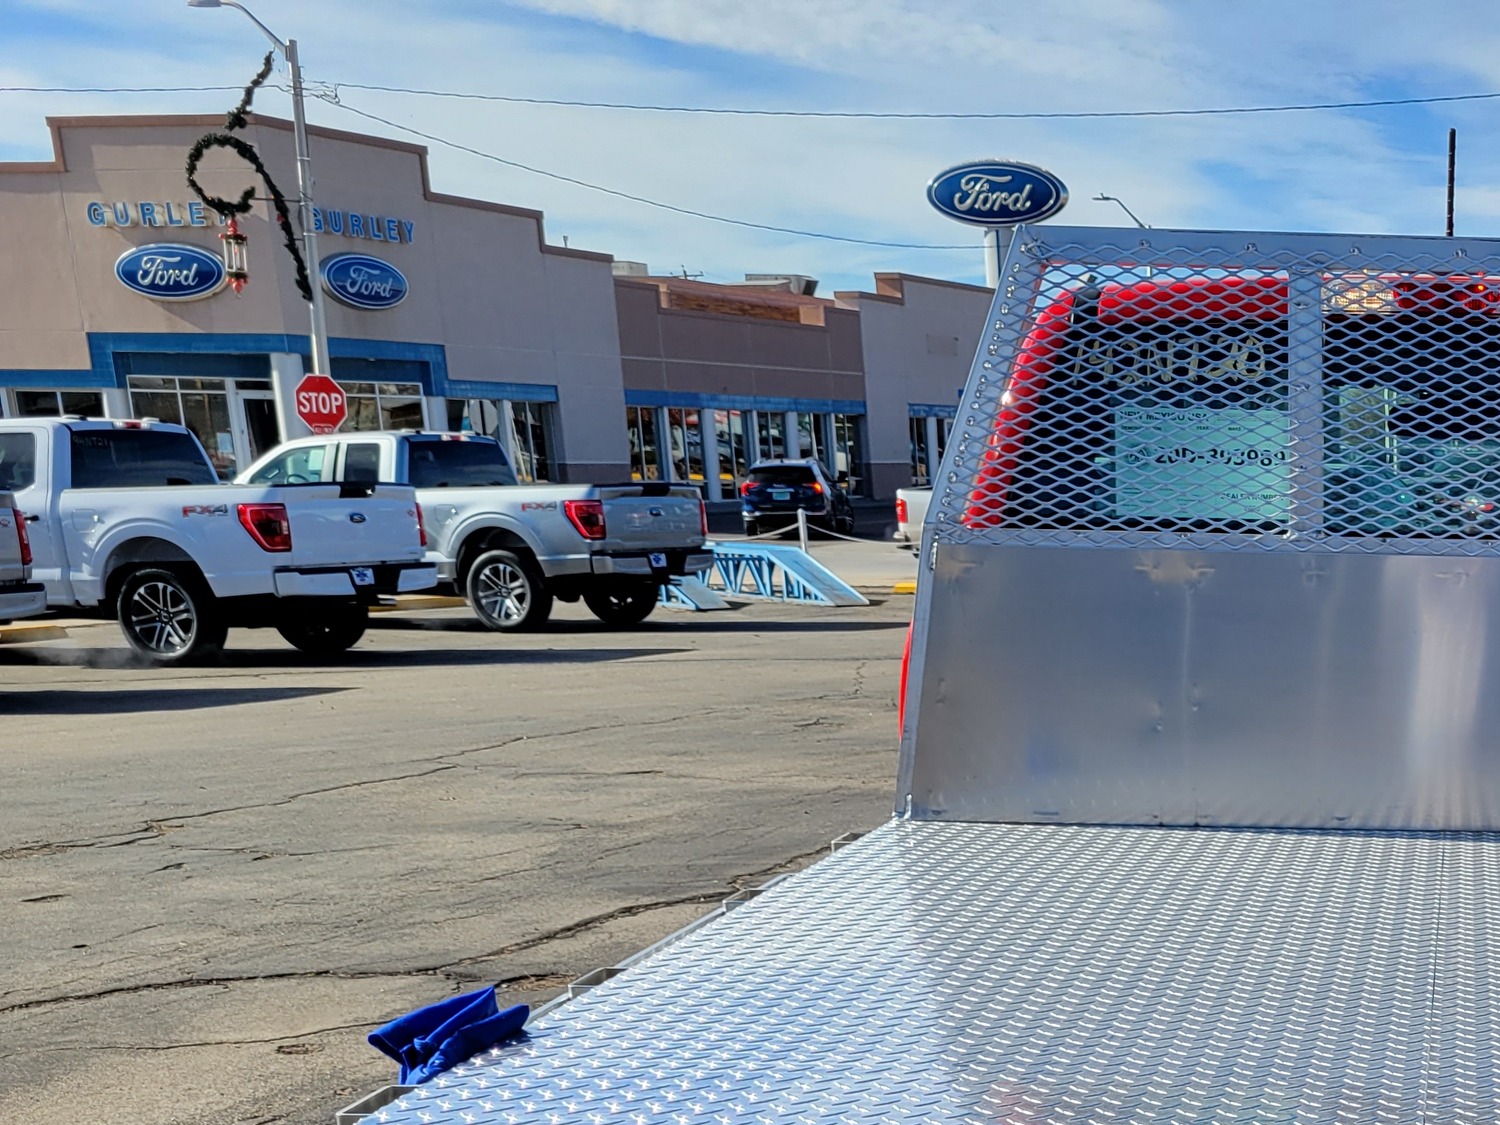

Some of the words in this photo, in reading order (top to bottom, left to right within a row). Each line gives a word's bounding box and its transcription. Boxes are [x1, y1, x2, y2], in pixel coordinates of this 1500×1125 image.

[953, 173, 1033, 212] Ford
[137, 255, 199, 286] Ford
[346, 265, 394, 298] Ford
[299, 391, 343, 414] STOP
[182, 504, 229, 518] FX4
